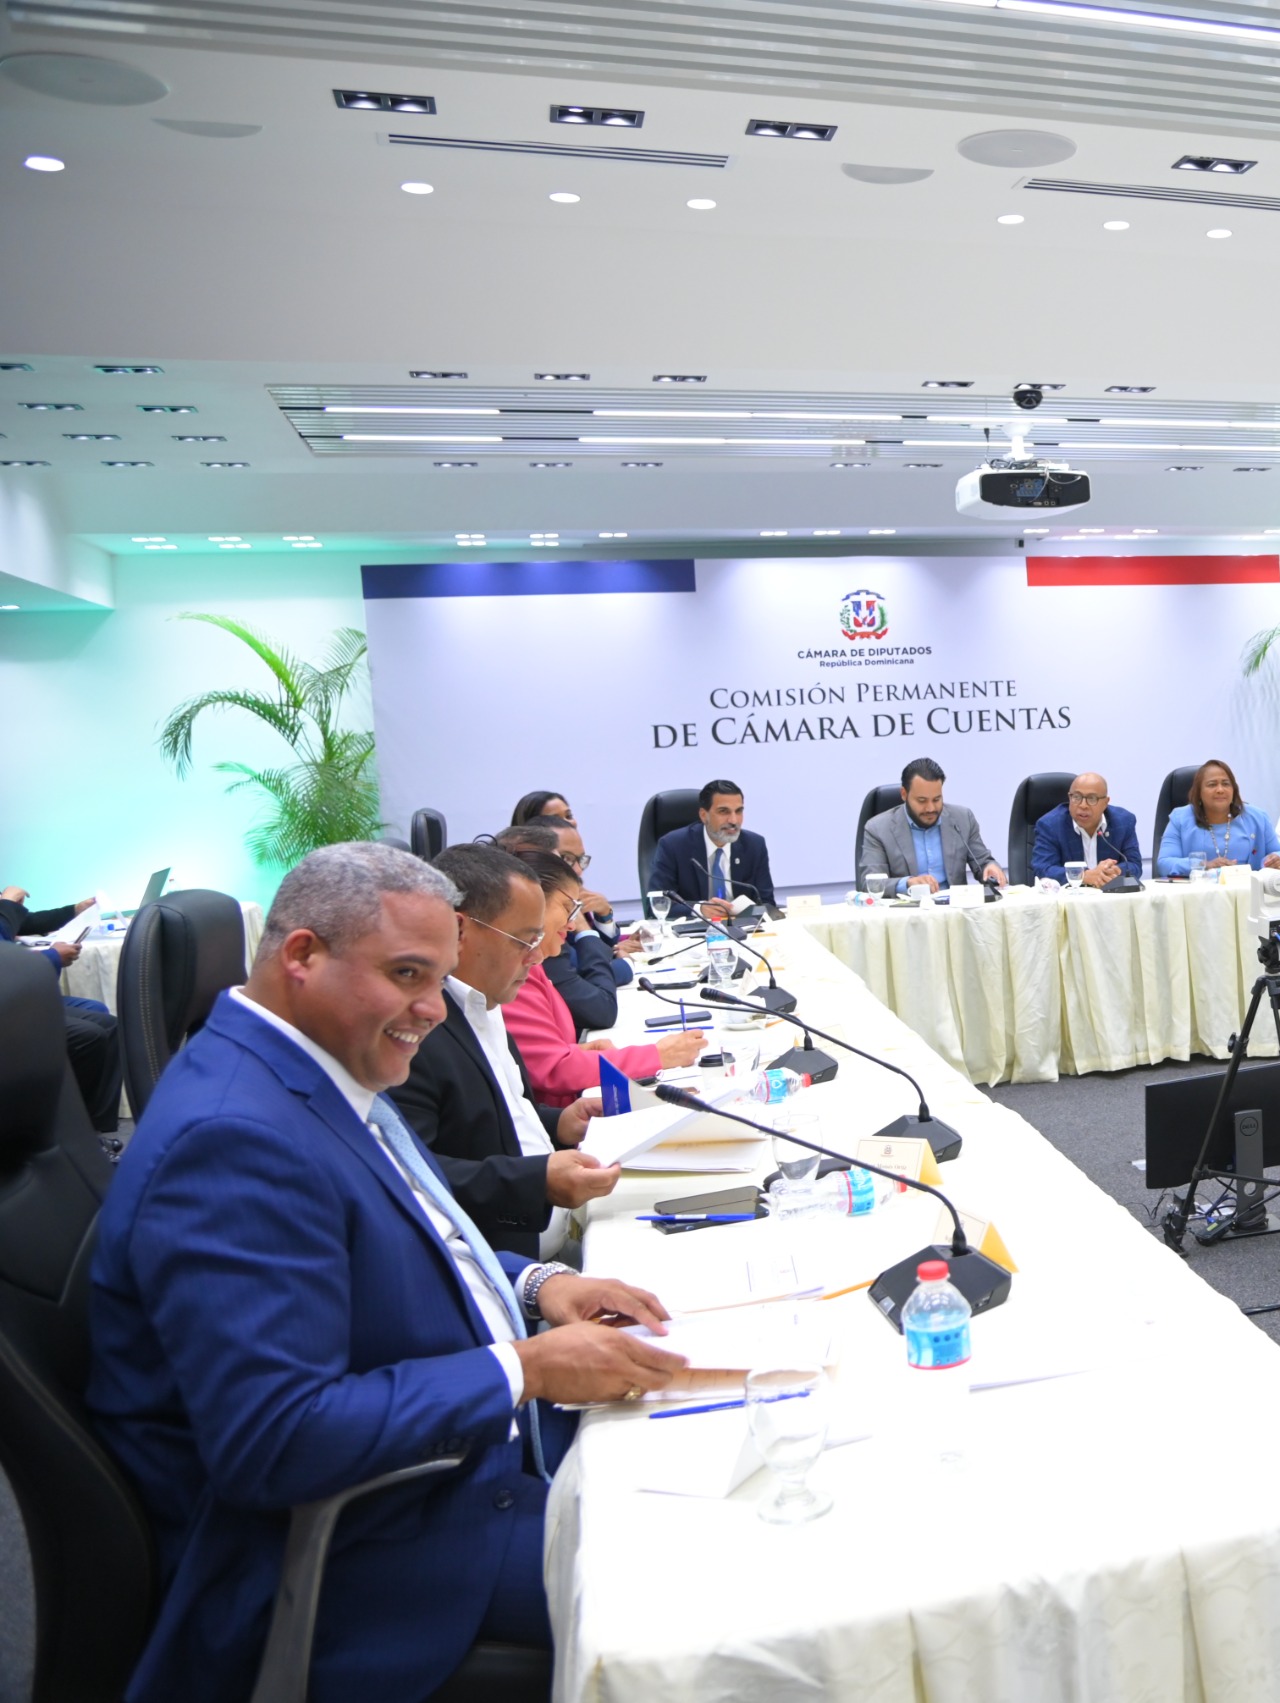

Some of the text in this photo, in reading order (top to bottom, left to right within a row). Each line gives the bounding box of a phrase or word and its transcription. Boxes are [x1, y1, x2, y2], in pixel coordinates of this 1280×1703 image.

[797, 646, 932, 659] CÁMARA DE DIPUTADOS
[819, 658, 914, 668] República Dominicana
[709, 680, 1017, 709] COMISIÓN PERMANENTE
[651, 706, 1071, 749] DE CÁMARA DE CUENTAS
